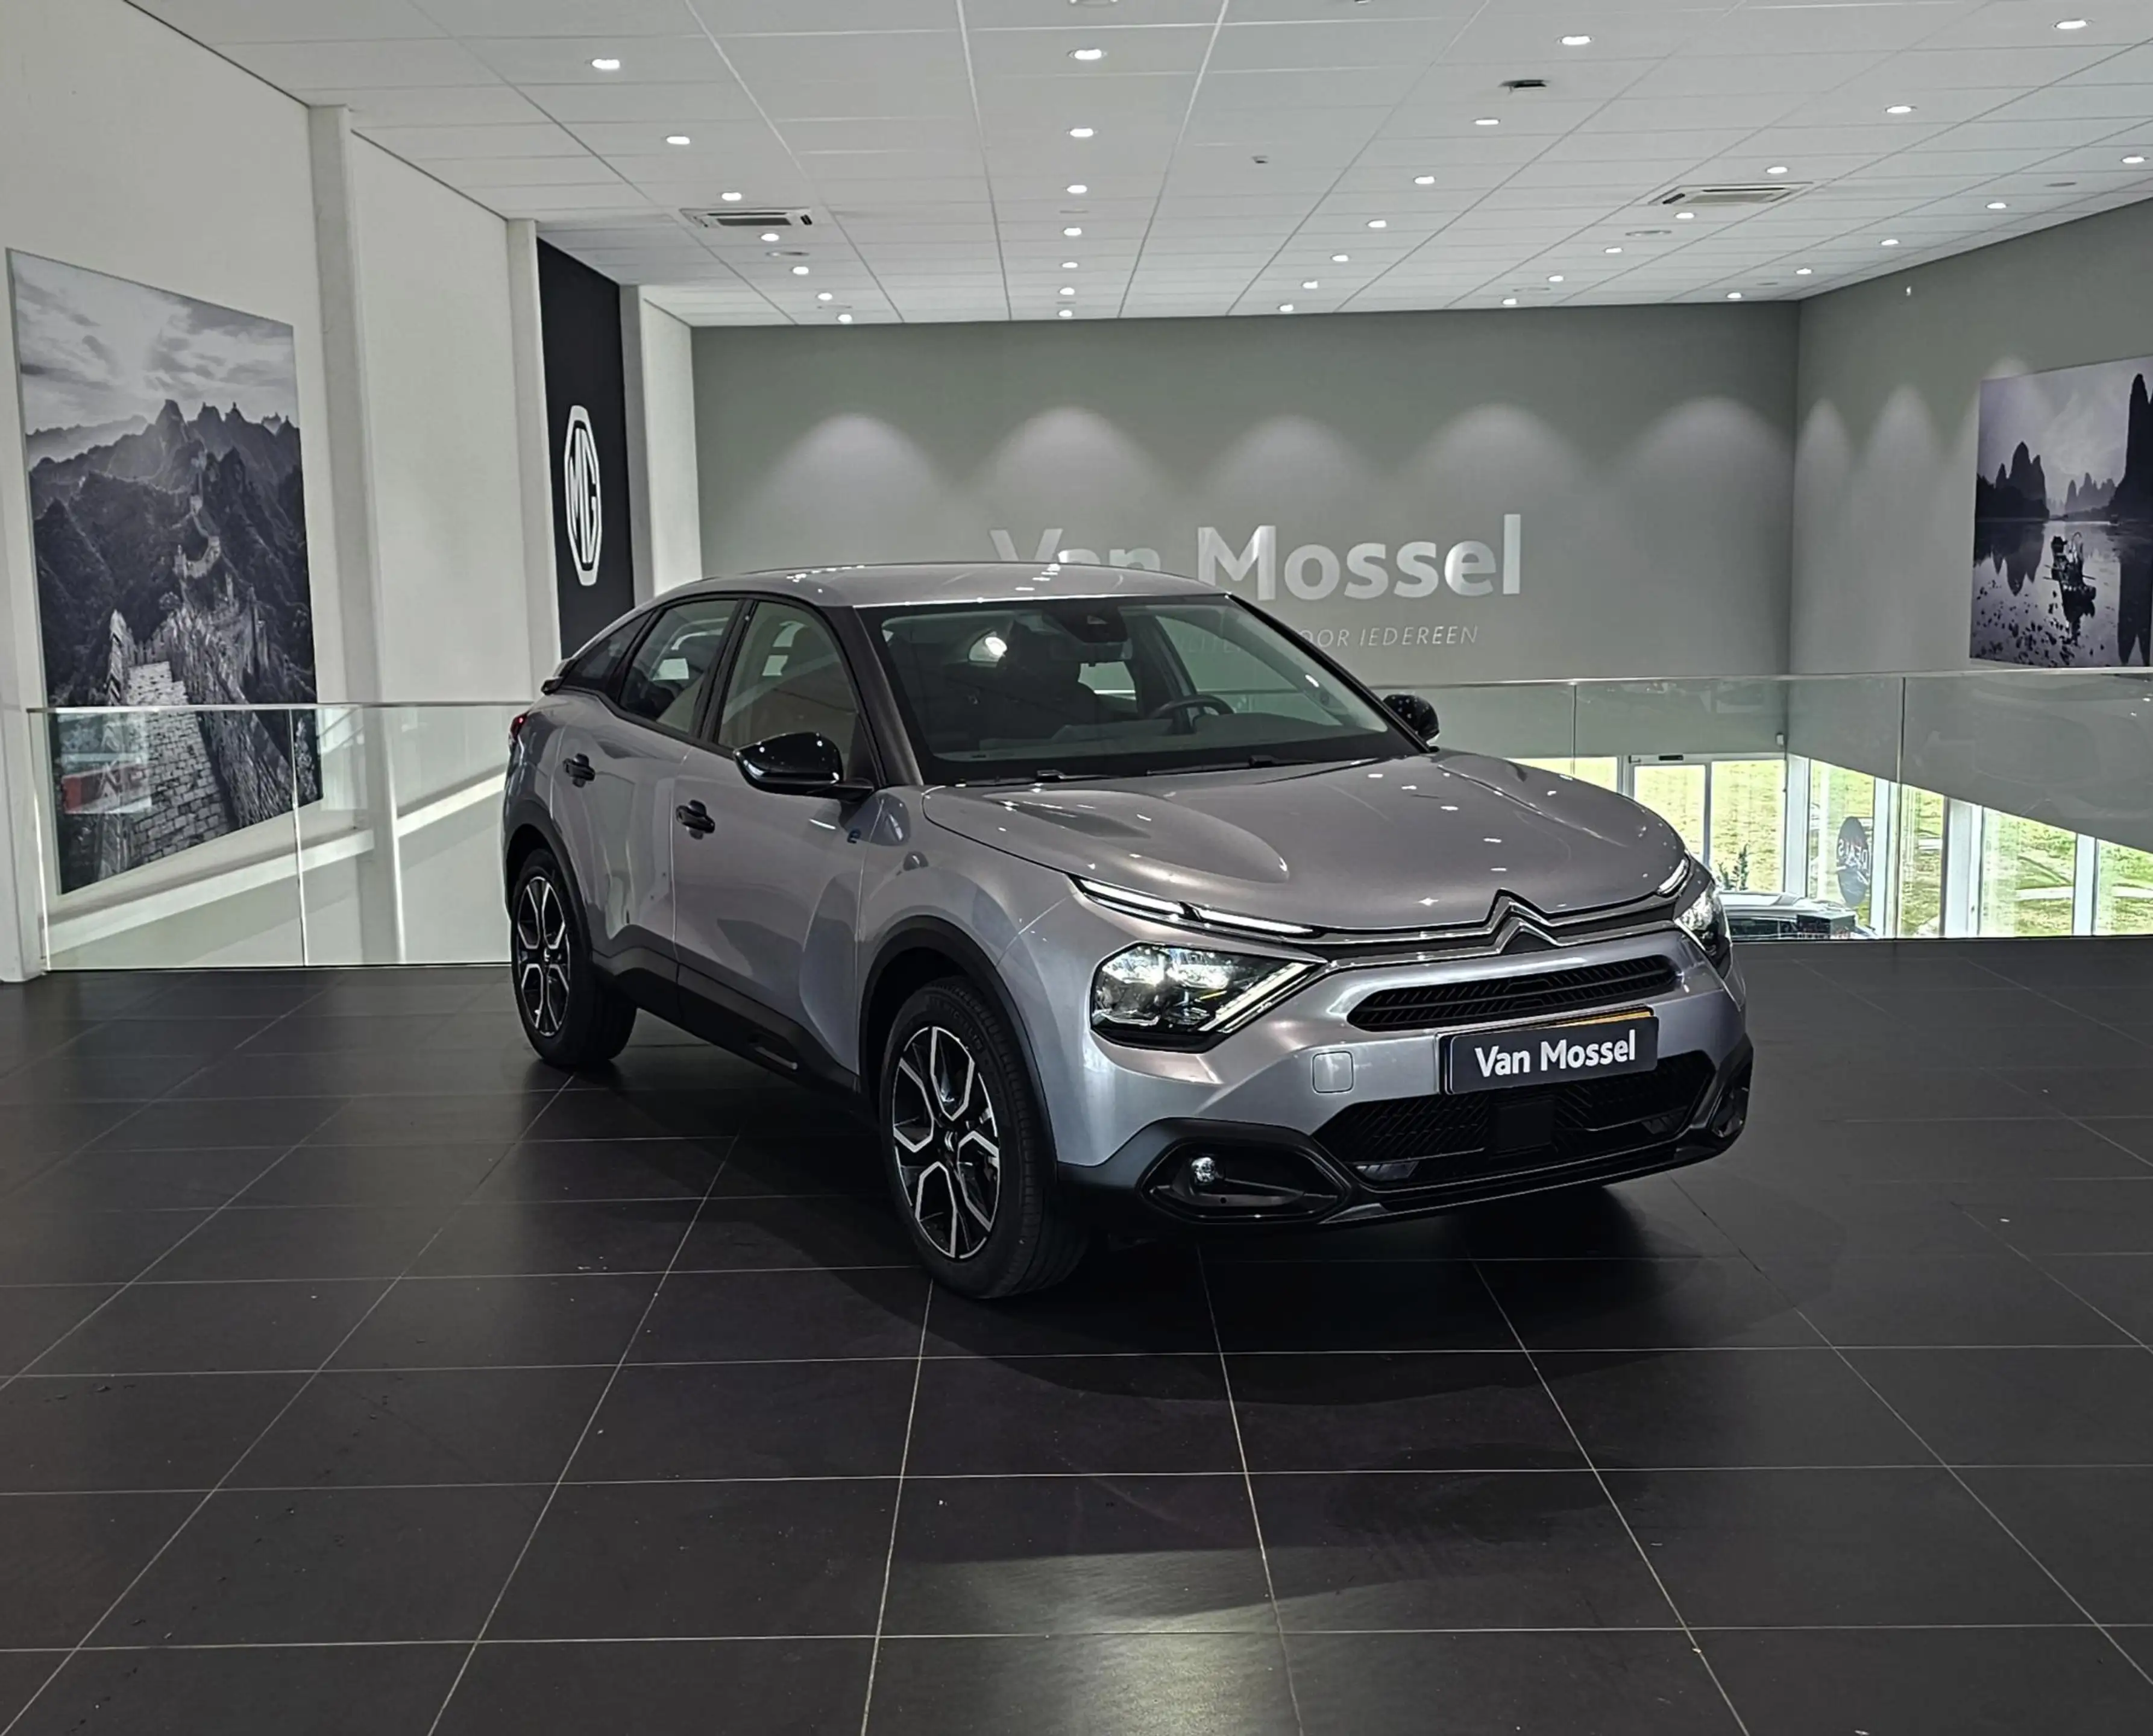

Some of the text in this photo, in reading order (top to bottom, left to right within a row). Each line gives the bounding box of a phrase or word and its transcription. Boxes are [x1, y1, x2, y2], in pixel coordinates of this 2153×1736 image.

[568, 427, 597, 564] MG
[1197, 513, 1522, 601] Mossel
[1359, 625, 1479, 647] IEDEREEN
[1474, 1028, 1636, 1078] Van Mossel
